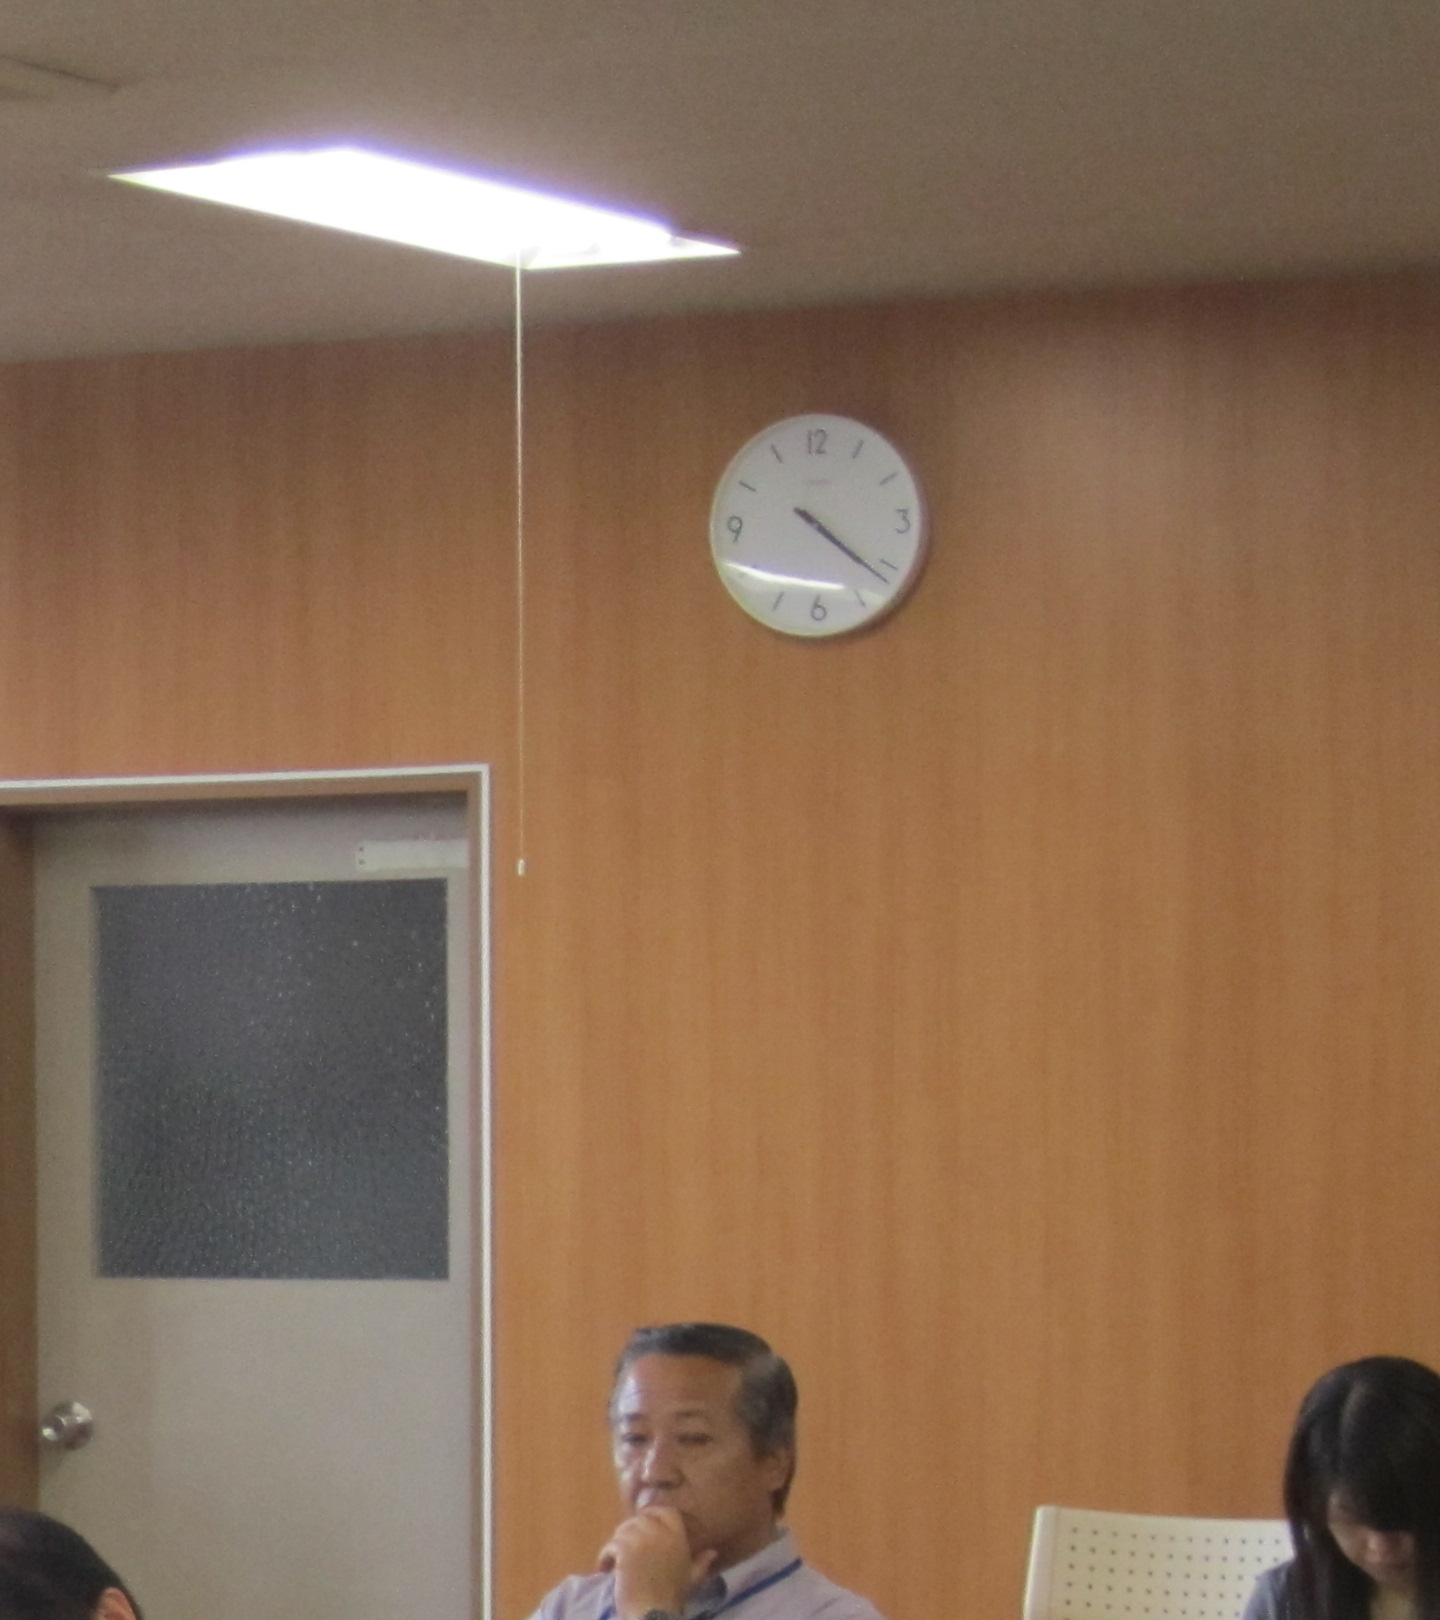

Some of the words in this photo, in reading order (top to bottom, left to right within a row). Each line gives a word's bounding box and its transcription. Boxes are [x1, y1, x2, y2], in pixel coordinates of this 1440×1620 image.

[806, 428, 828, 455] 12
[726, 515, 744, 543] 9
[894, 508, 911, 534] 3
[810, 595, 828, 622] 6
